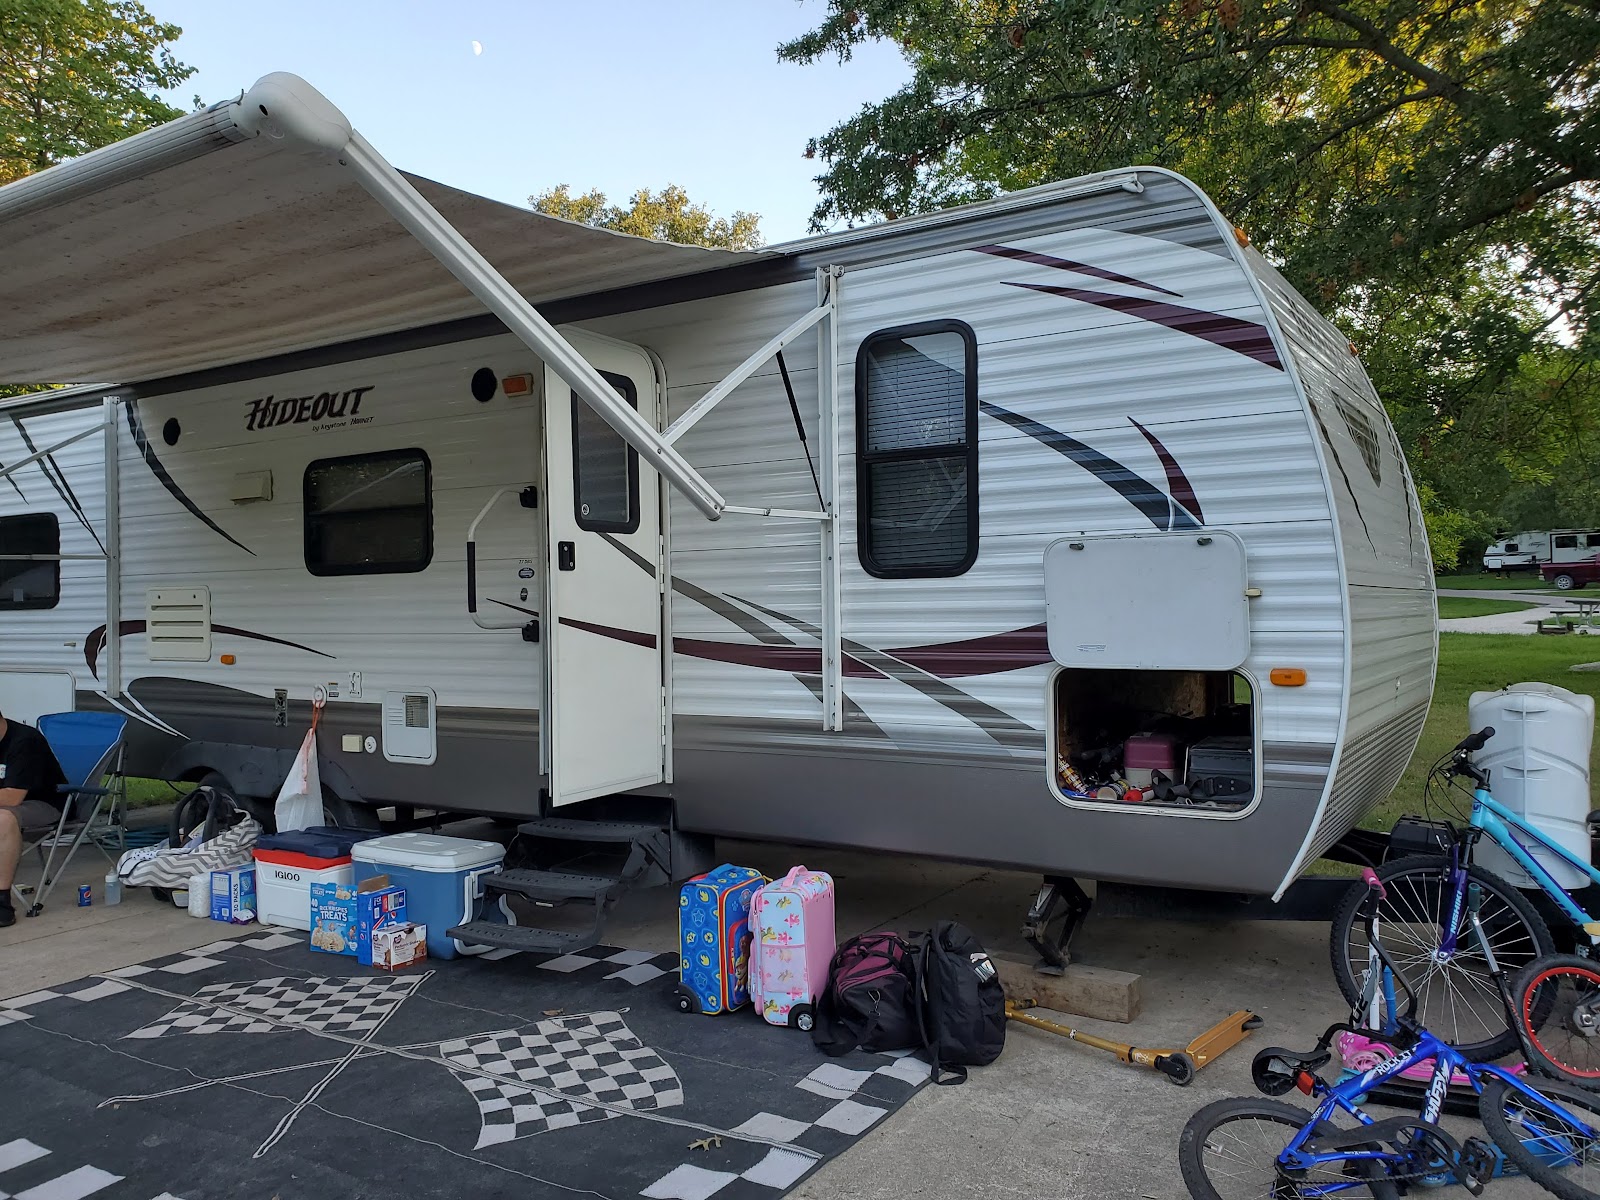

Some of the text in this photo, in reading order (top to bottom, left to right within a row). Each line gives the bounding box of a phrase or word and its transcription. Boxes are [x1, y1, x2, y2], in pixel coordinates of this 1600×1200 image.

[244, 385, 375, 431] HIDEOUT
[275, 870, 300, 882] IGLOO
[320, 911, 348, 922] TREATS
[1450, 890, 1463, 935] NISHIKI
[1376, 1049, 1412, 1076] ROCK IT
[1427, 1070, 1447, 1118] HUFFY
